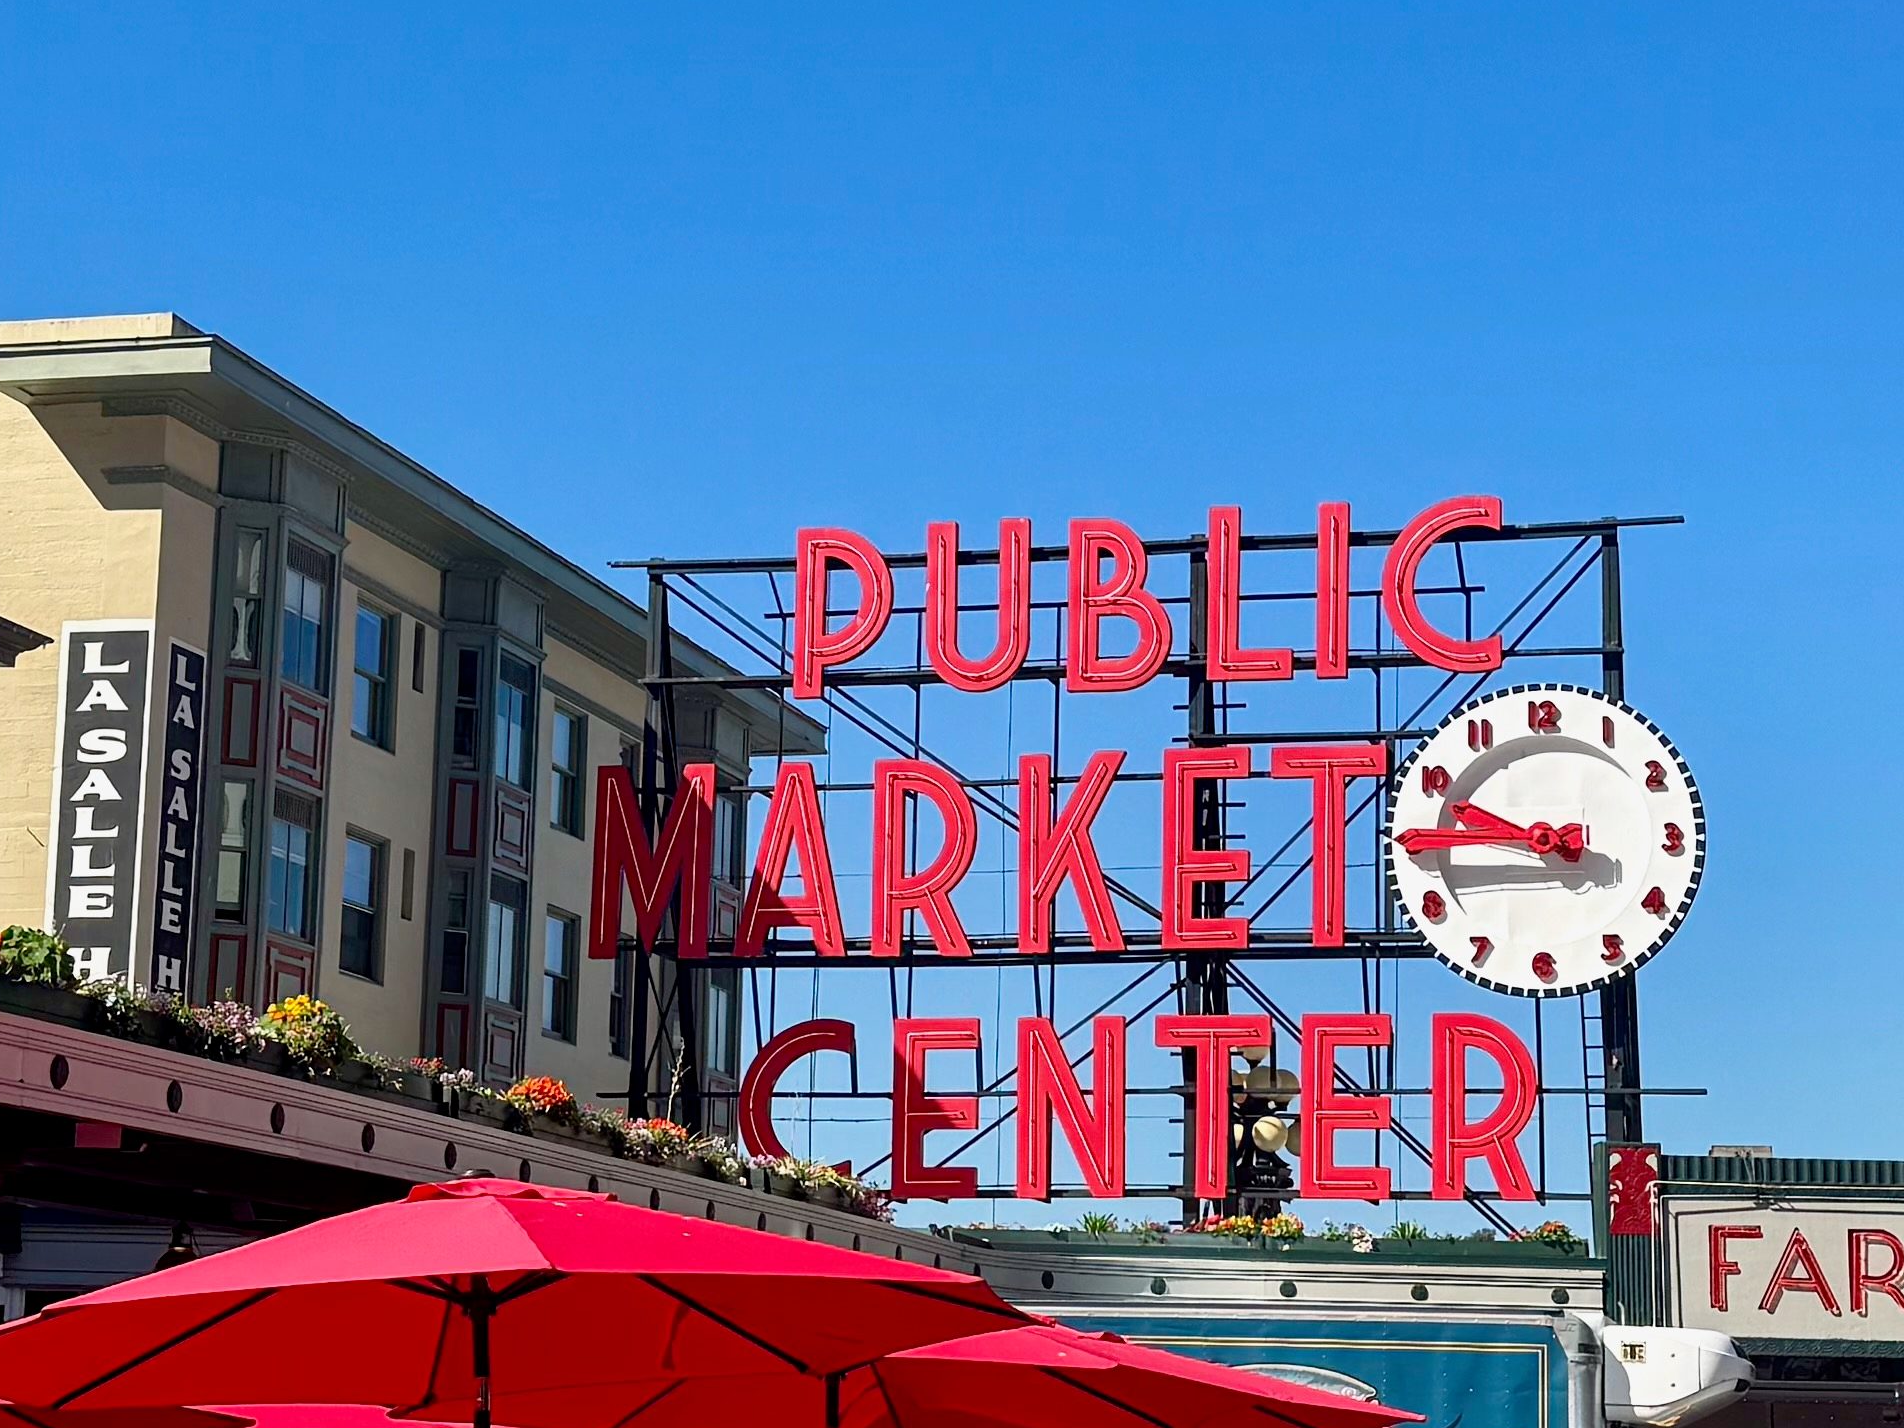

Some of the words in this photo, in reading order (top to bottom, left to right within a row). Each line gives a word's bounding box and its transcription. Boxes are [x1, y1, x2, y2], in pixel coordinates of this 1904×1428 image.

[792, 494, 1503, 700] PUBLIC
[76, 641, 130, 713] LA
[172, 654, 197, 730] LA
[1528, 700, 1560, 733] 12
[1603, 716, 1614, 748] 1
[1468, 719, 1493, 751] 11
[1422, 765, 1452, 797] 10
[1645, 760, 1668, 792] 2
[68, 728, 128, 920] SALLE
[1662, 823, 1685, 856] 3
[159, 749, 193, 936] SALLE
[590, 742, 1388, 959] MARKET
[1422, 890, 1447, 924] 8
[1641, 887, 1669, 919] 4
[1469, 936, 1494, 968] 7
[1601, 934, 1625, 966] 5
[1532, 952, 1558, 984] 6
[738, 1012, 1536, 1201] CENTER
